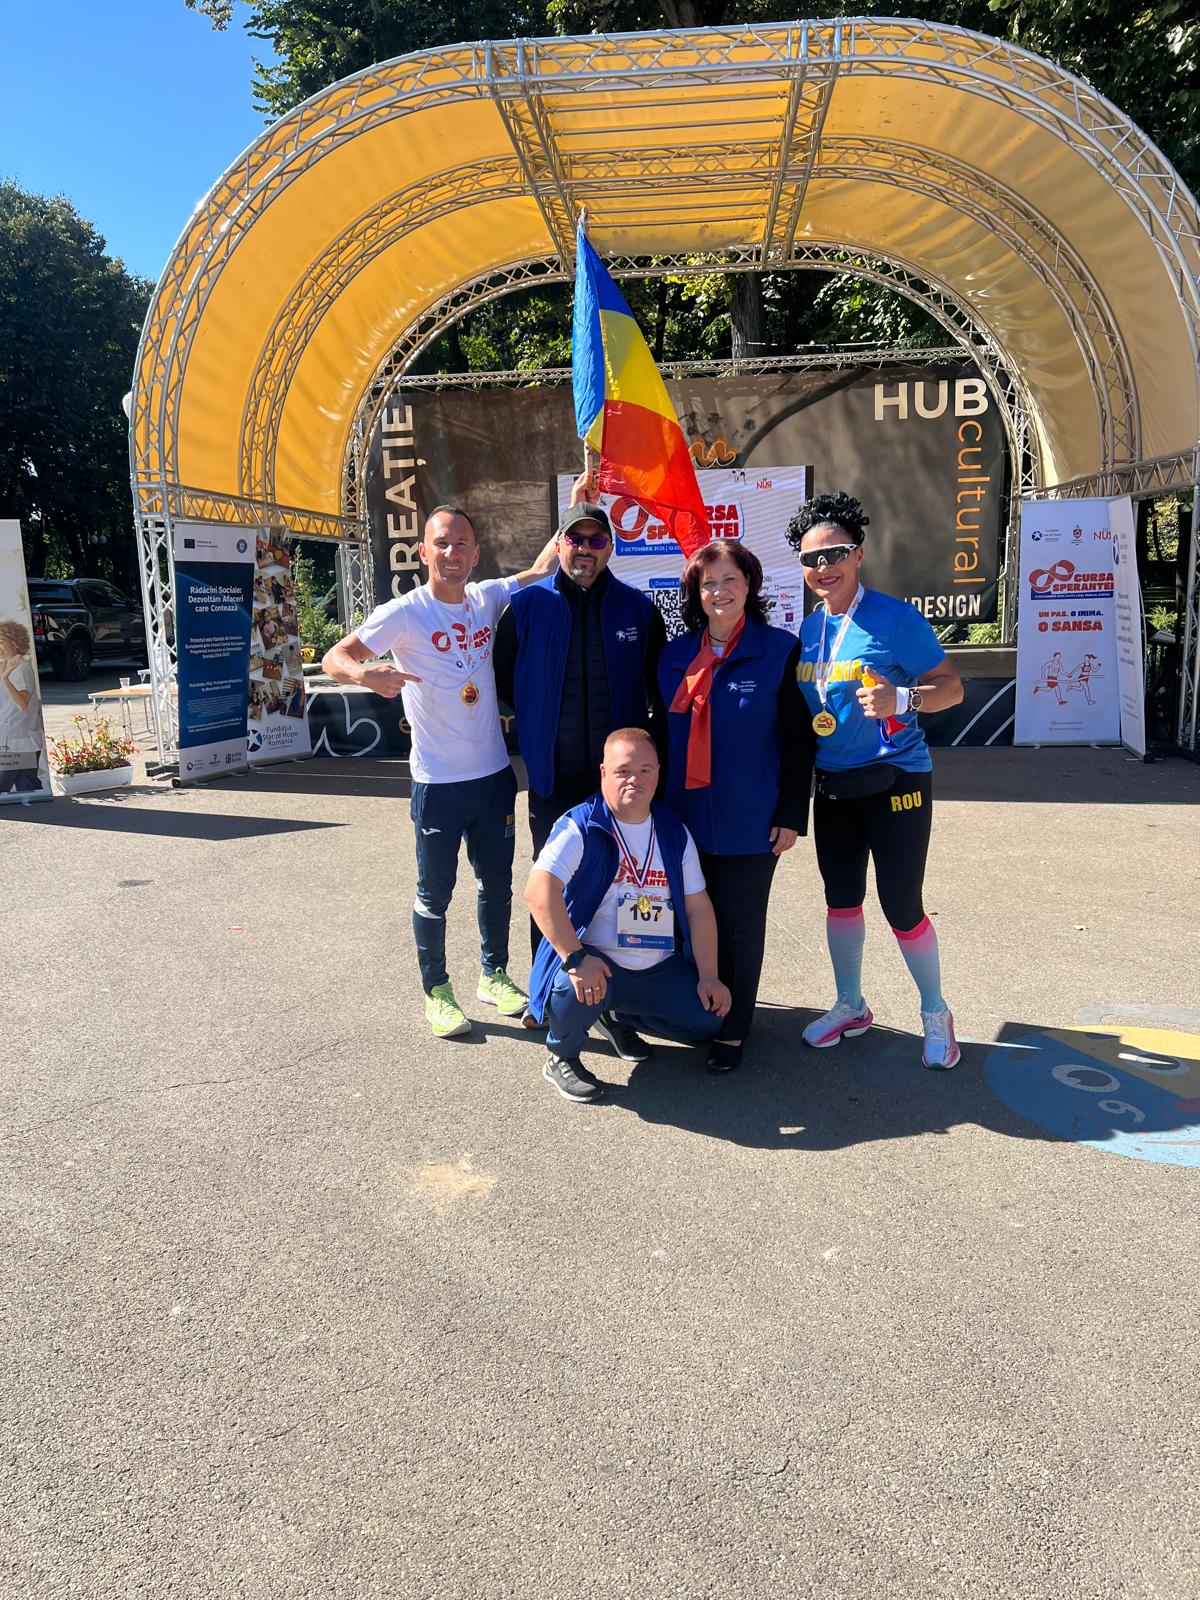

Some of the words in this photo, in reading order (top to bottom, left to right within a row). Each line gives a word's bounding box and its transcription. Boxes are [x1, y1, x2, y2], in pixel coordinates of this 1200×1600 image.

[874, 378, 989, 421] HUB
[953, 420, 991, 584] cultural
[1074, 573, 1114, 582] CURSA
[218, 585, 243, 594] Sociale:
[222, 594, 244, 603] Afaceri
[1038, 621, 1049, 632] O
[890, 791, 922, 812] ROU
